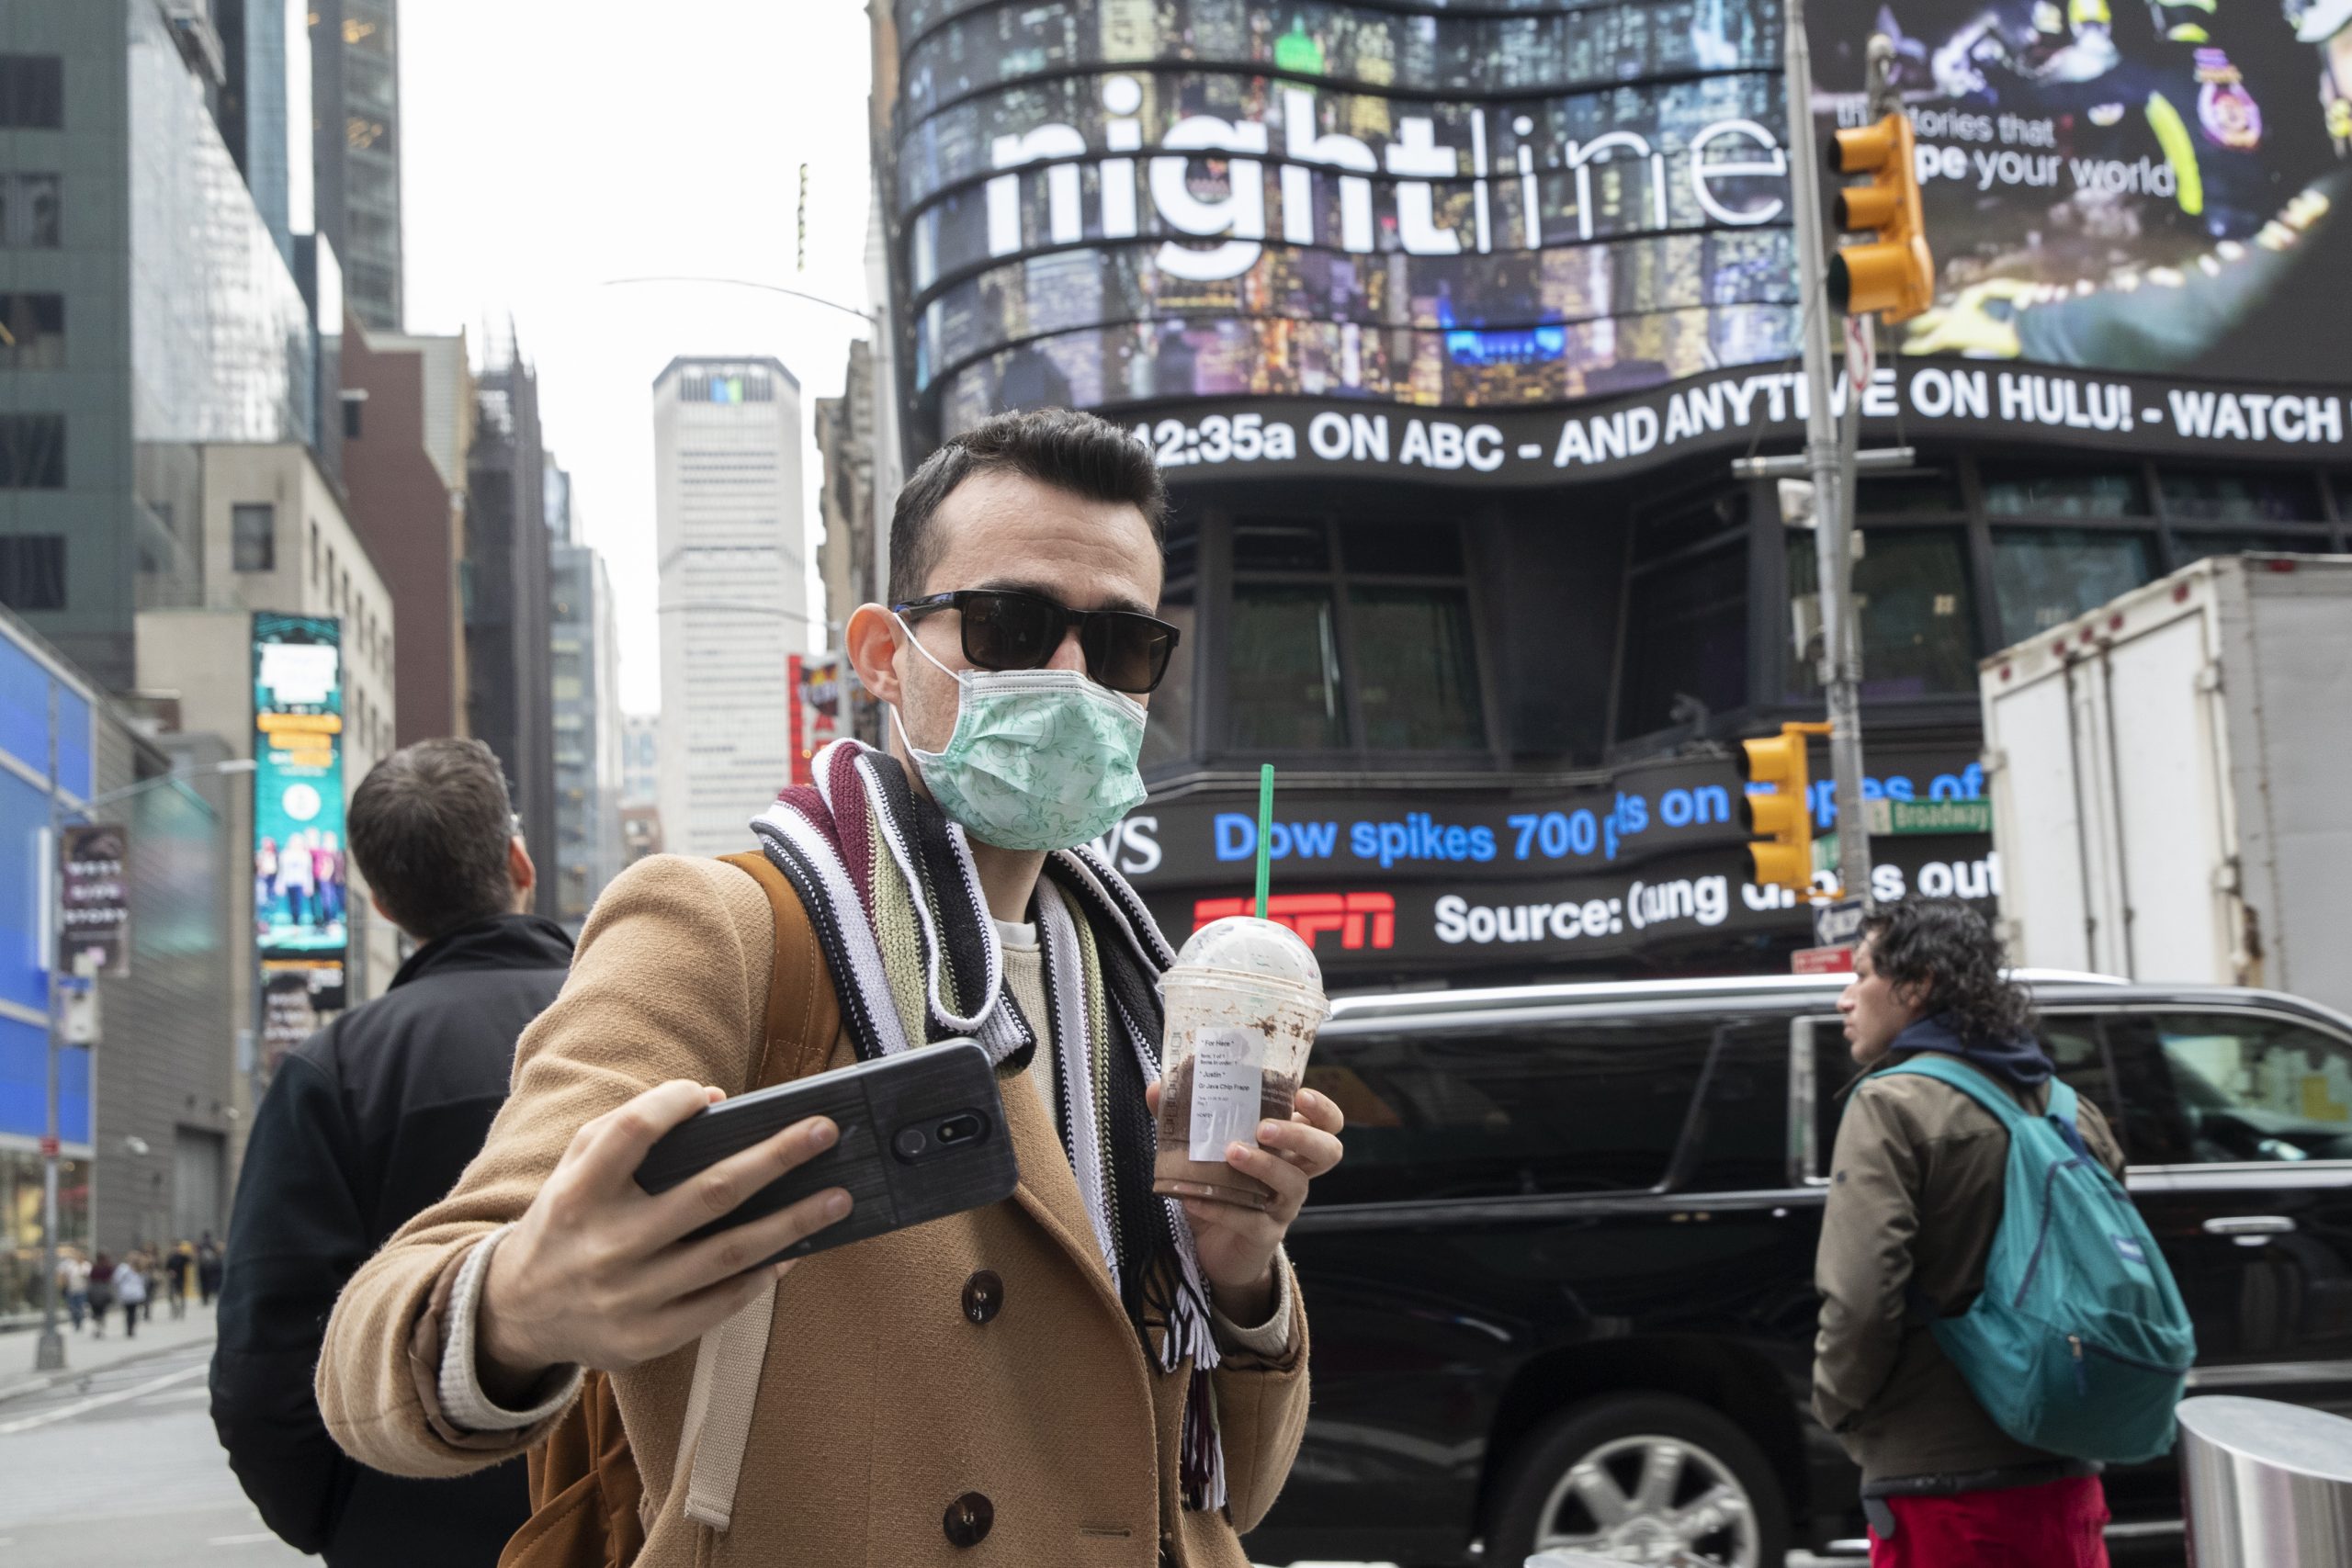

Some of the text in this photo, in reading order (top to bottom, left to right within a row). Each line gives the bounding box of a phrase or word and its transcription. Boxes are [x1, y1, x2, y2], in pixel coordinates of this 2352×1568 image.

[1838, 97, 2055, 148] th tories that
[987, 75, 1788, 281] nightline
[1974, 150, 2063, 190] your
[2069, 155, 2176, 197] world
[1133, 413, 1296, 467] 12:35a
[1308, 412, 1390, 461] ON
[1400, 419, 1505, 471] ABC
[1554, 405, 1658, 468] AND
[1910, 367, 1989, 419] ON
[1998, 372, 2133, 432] HULU!
[2168, 389, 2343, 443] WATCH
[1214, 812, 1338, 862] Dow
[1351, 811, 1497, 868] spikes
[1507, 809, 1597, 861] 700
[1660, 784, 1730, 827] on
[1929, 761, 1984, 801] of
[1434, 894, 1623, 944] Source:
